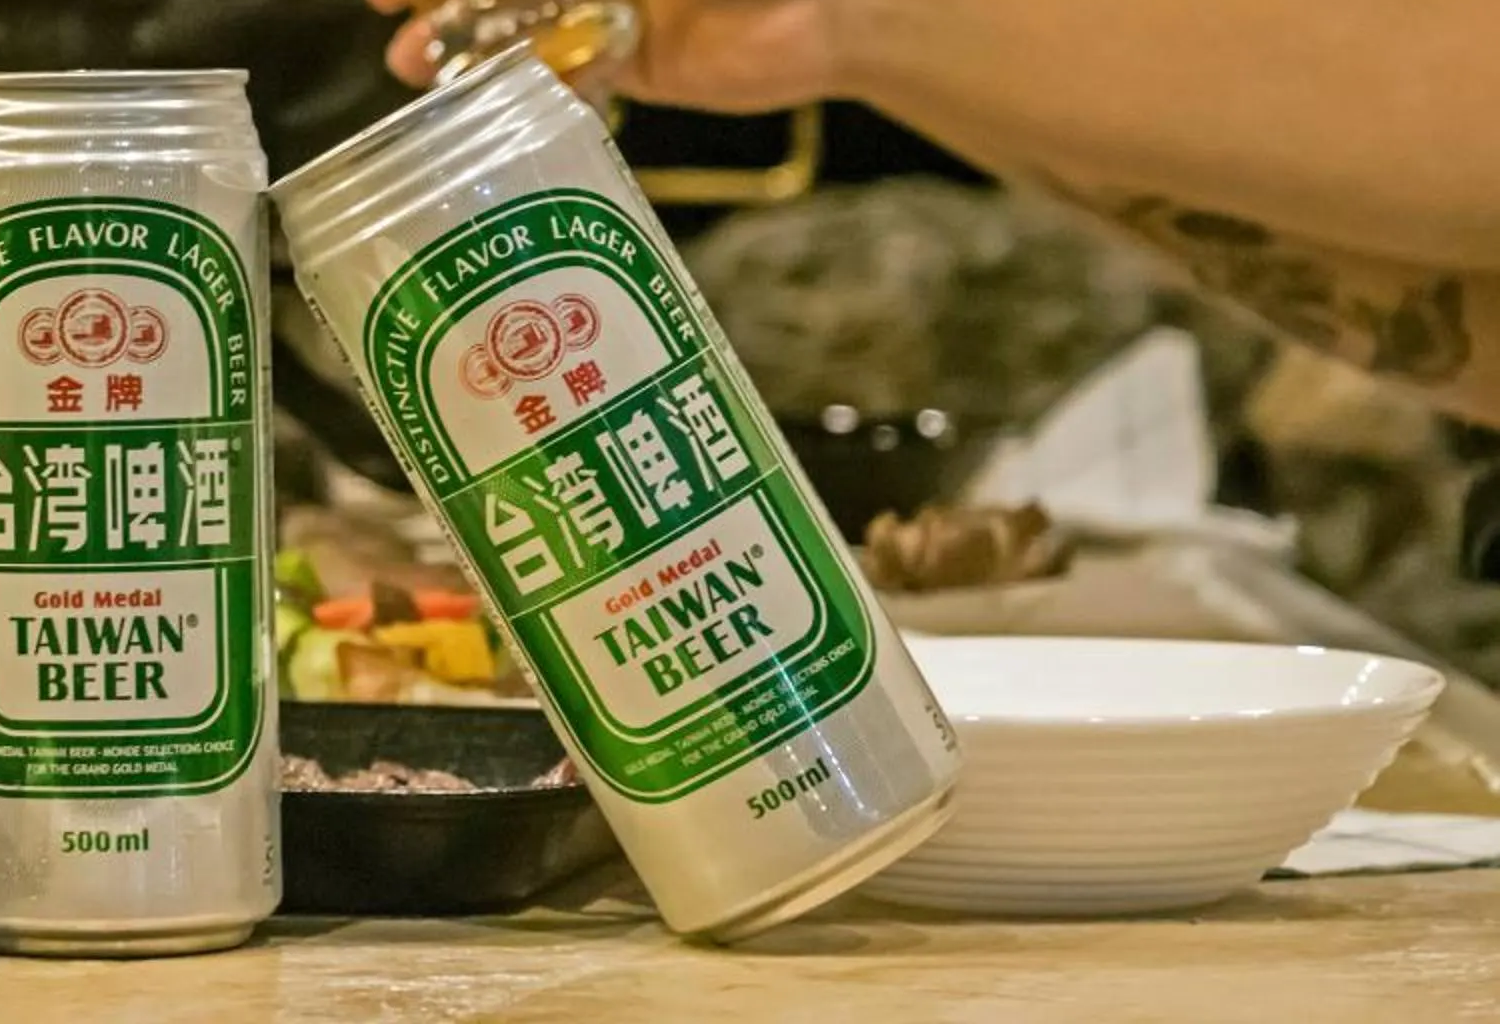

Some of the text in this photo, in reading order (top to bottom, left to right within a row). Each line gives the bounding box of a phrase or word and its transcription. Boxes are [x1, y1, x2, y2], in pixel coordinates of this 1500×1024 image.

[29, 221, 150, 253] FLAVOR
[168, 233, 235, 313] LAGER
[227, 334, 247, 406] BEER
[386, 308, 450, 485] DISTINCTIVE
[421, 225, 536, 303] FLAVOR
[550, 215, 637, 266] LAGER
[648, 274, 695, 342] BEER
[46, 373, 144, 413] 金牌
[513, 360, 607, 435] 金牌
[34, 589, 162, 609] Gold Medal
[605, 537, 723, 616] Gold Medal
[38, 661, 168, 702] BEER
[643, 603, 775, 697] BEER
[112, 762, 143, 774] GOLD
